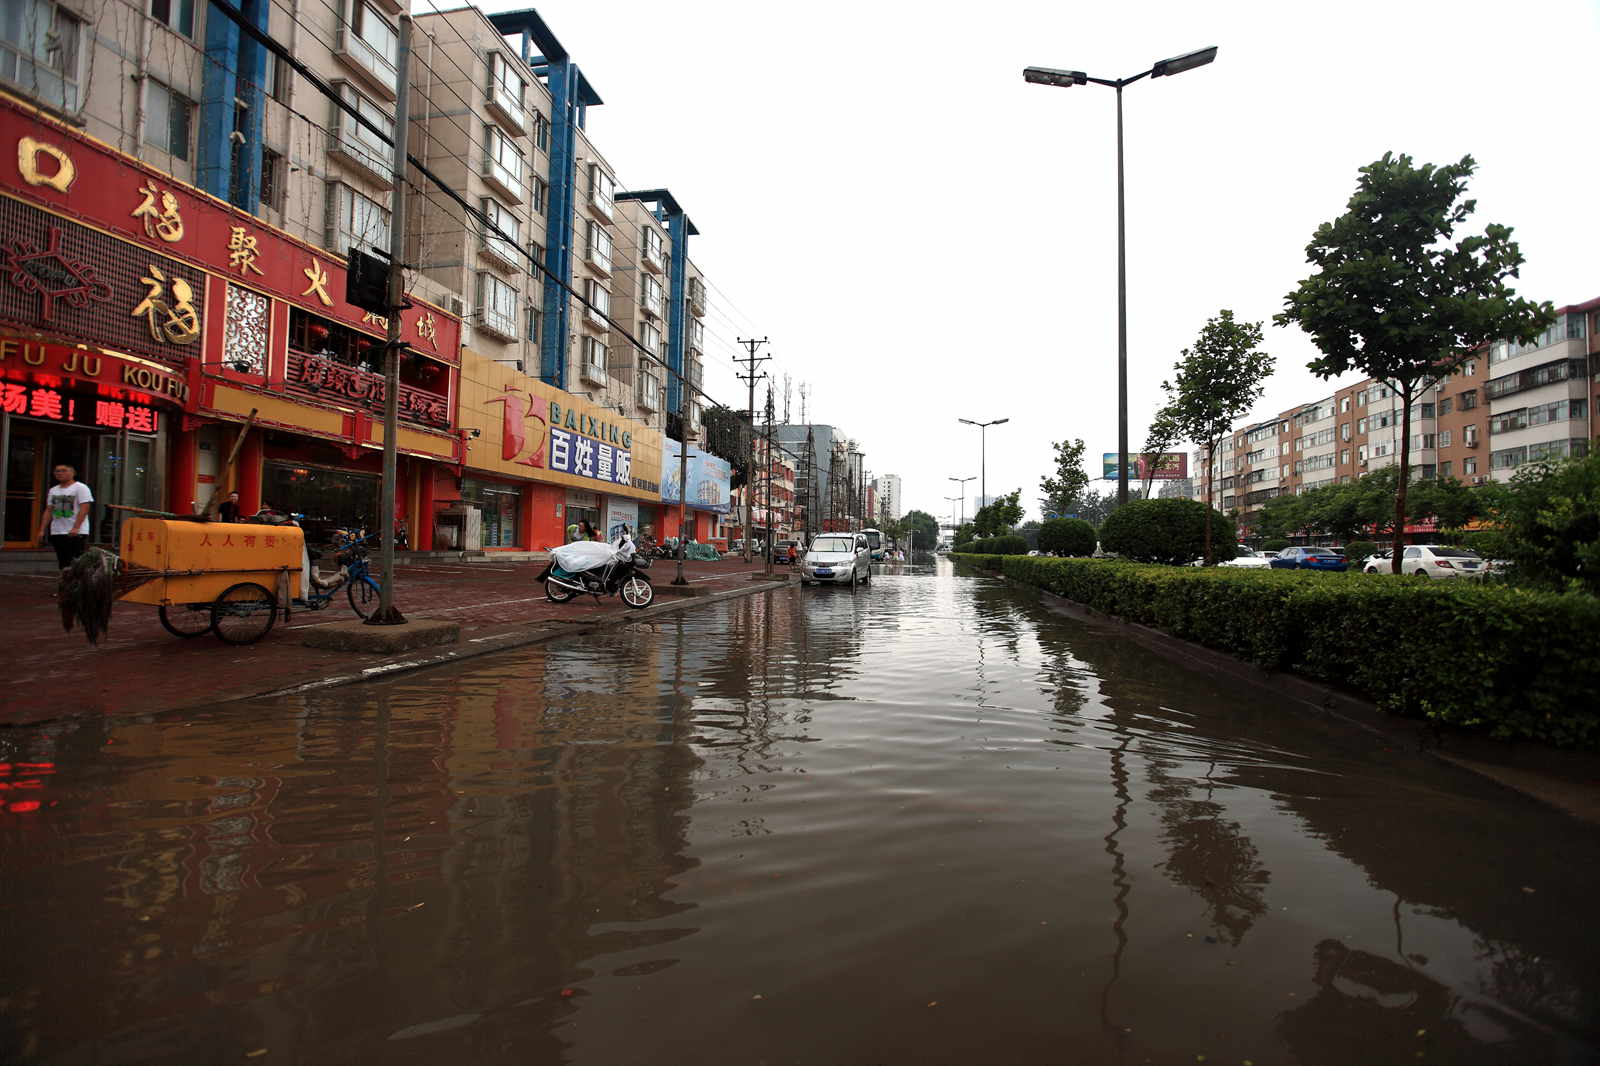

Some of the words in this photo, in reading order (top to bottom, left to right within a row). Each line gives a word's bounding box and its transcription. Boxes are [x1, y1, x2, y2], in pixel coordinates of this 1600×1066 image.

[131, 264, 201, 345] 福
[0, 340, 46, 366] FU
[63, 352, 101, 377] JU
[124, 364, 163, 391] KOU
[550, 401, 632, 449] BAIXING
[551, 428, 631, 486] 百姓量贩
